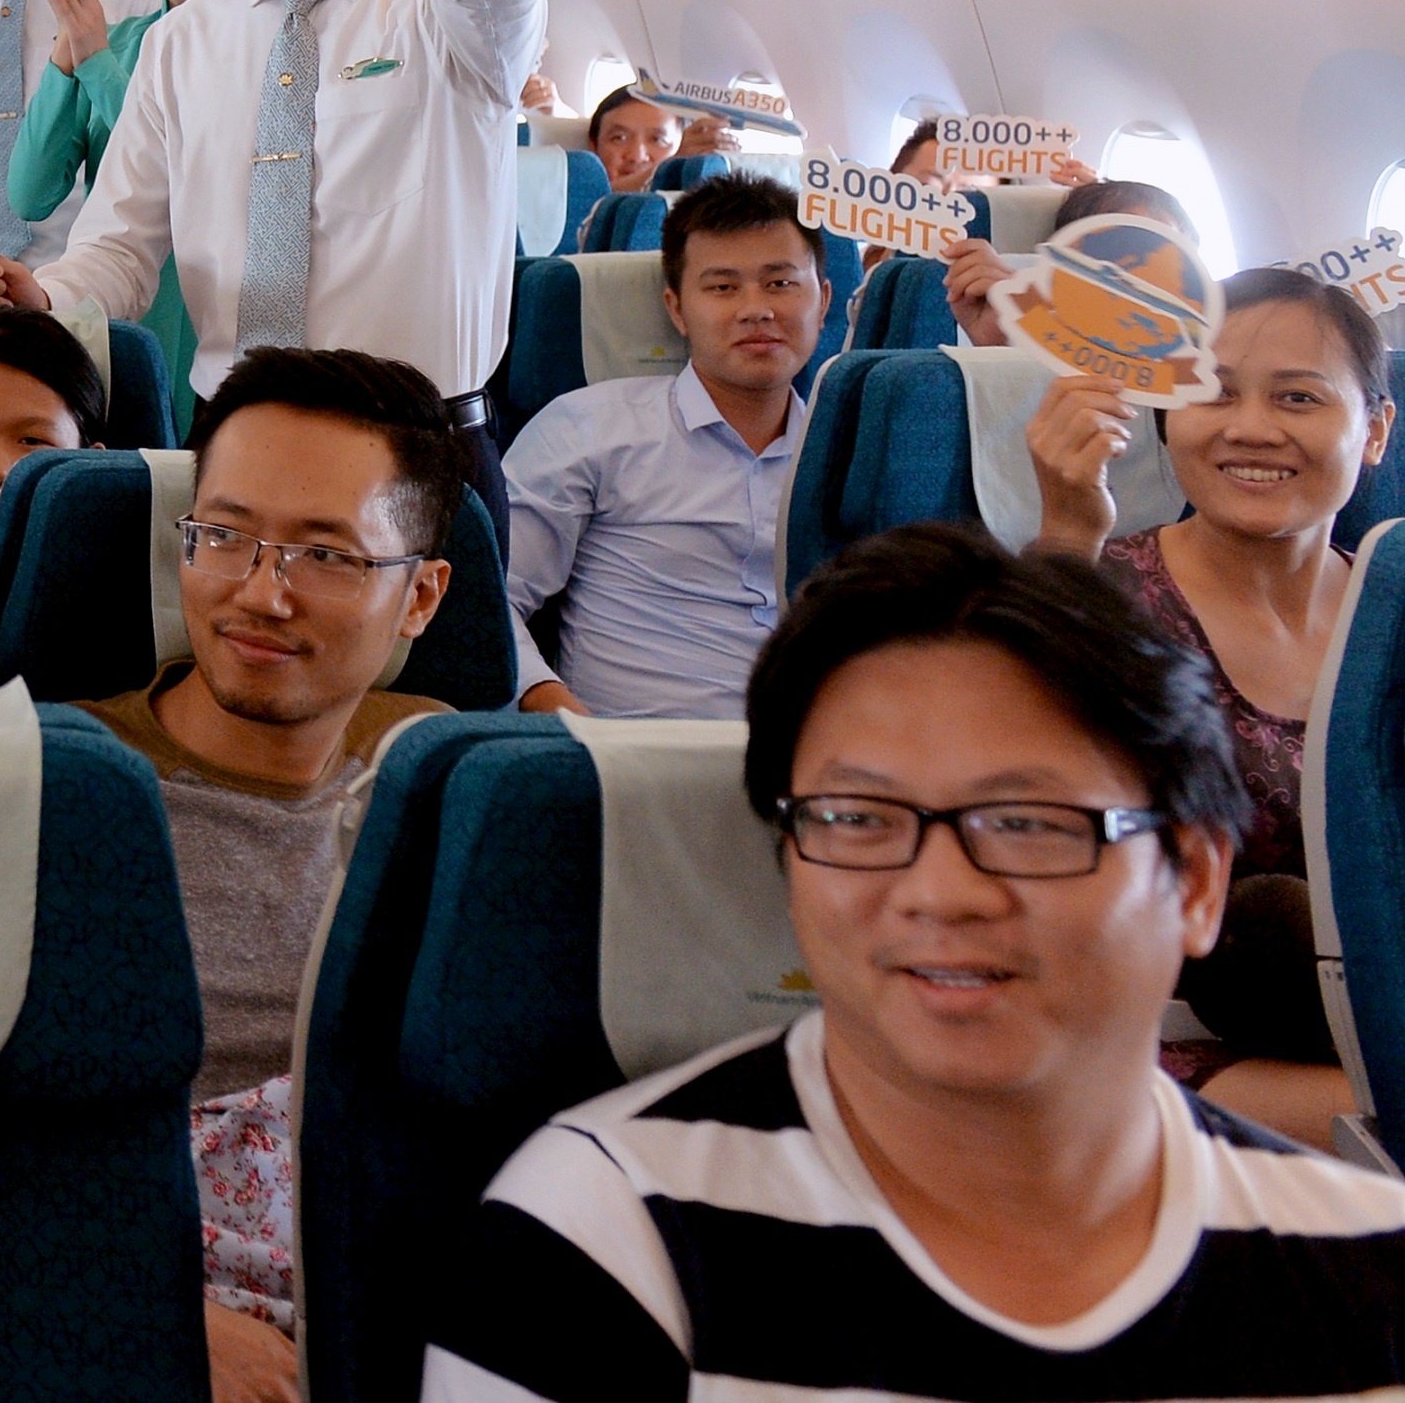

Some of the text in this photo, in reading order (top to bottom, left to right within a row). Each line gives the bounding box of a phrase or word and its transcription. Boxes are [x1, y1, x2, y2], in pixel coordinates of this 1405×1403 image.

[944, 119, 1072, 145] 8.000++
[942, 147, 1067, 175] FLIGHTS
[807, 159, 967, 218] 8.000++
[806, 193, 959, 257] FLIGHTS
